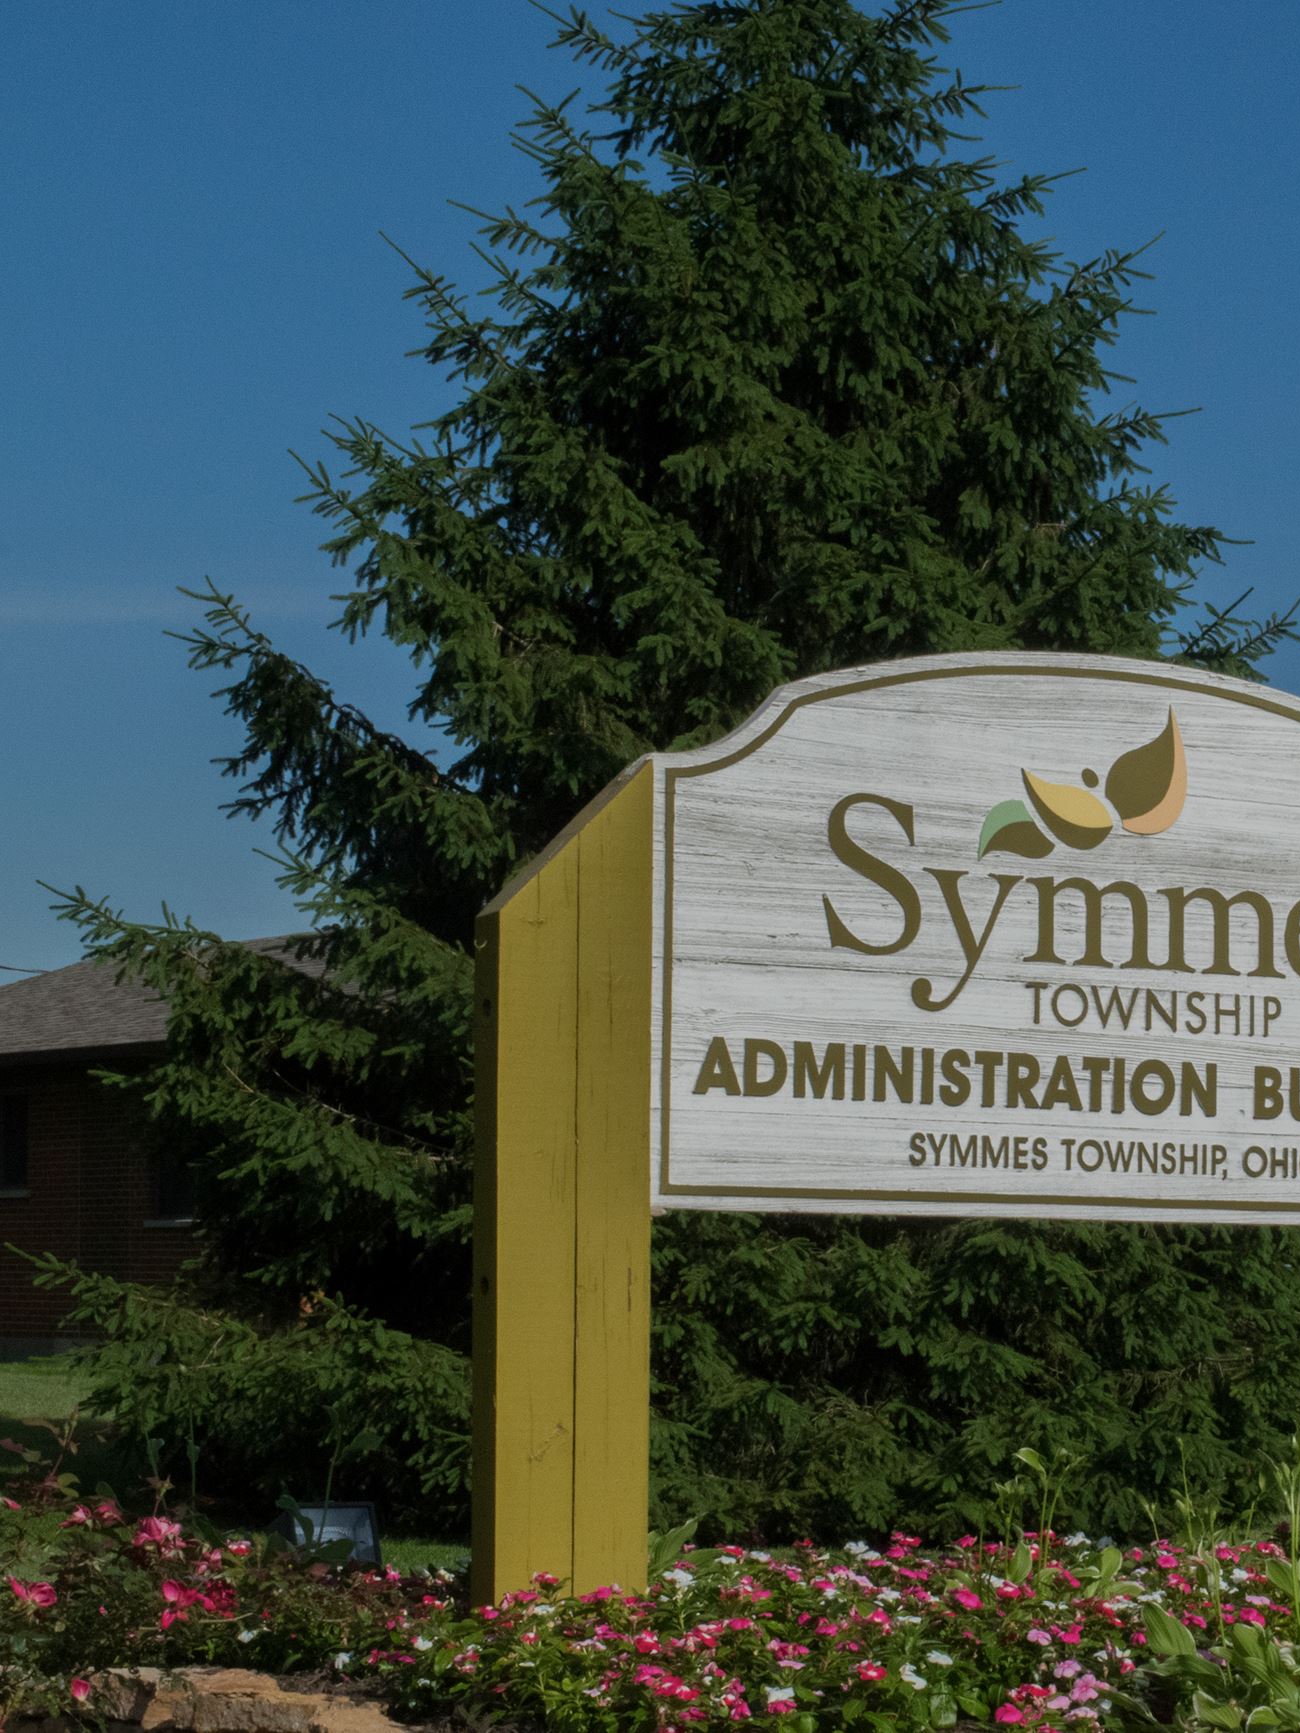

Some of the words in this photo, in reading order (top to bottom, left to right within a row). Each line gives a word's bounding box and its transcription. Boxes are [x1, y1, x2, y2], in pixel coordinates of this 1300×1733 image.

[1026, 982, 1282, 1037] TOWNSHIP
[693, 1036, 1218, 1117] ADMINISTRATION
[909, 1132, 1048, 1172] SYMMES
[1061, 1139, 1230, 1180] TOWNSHIP,
